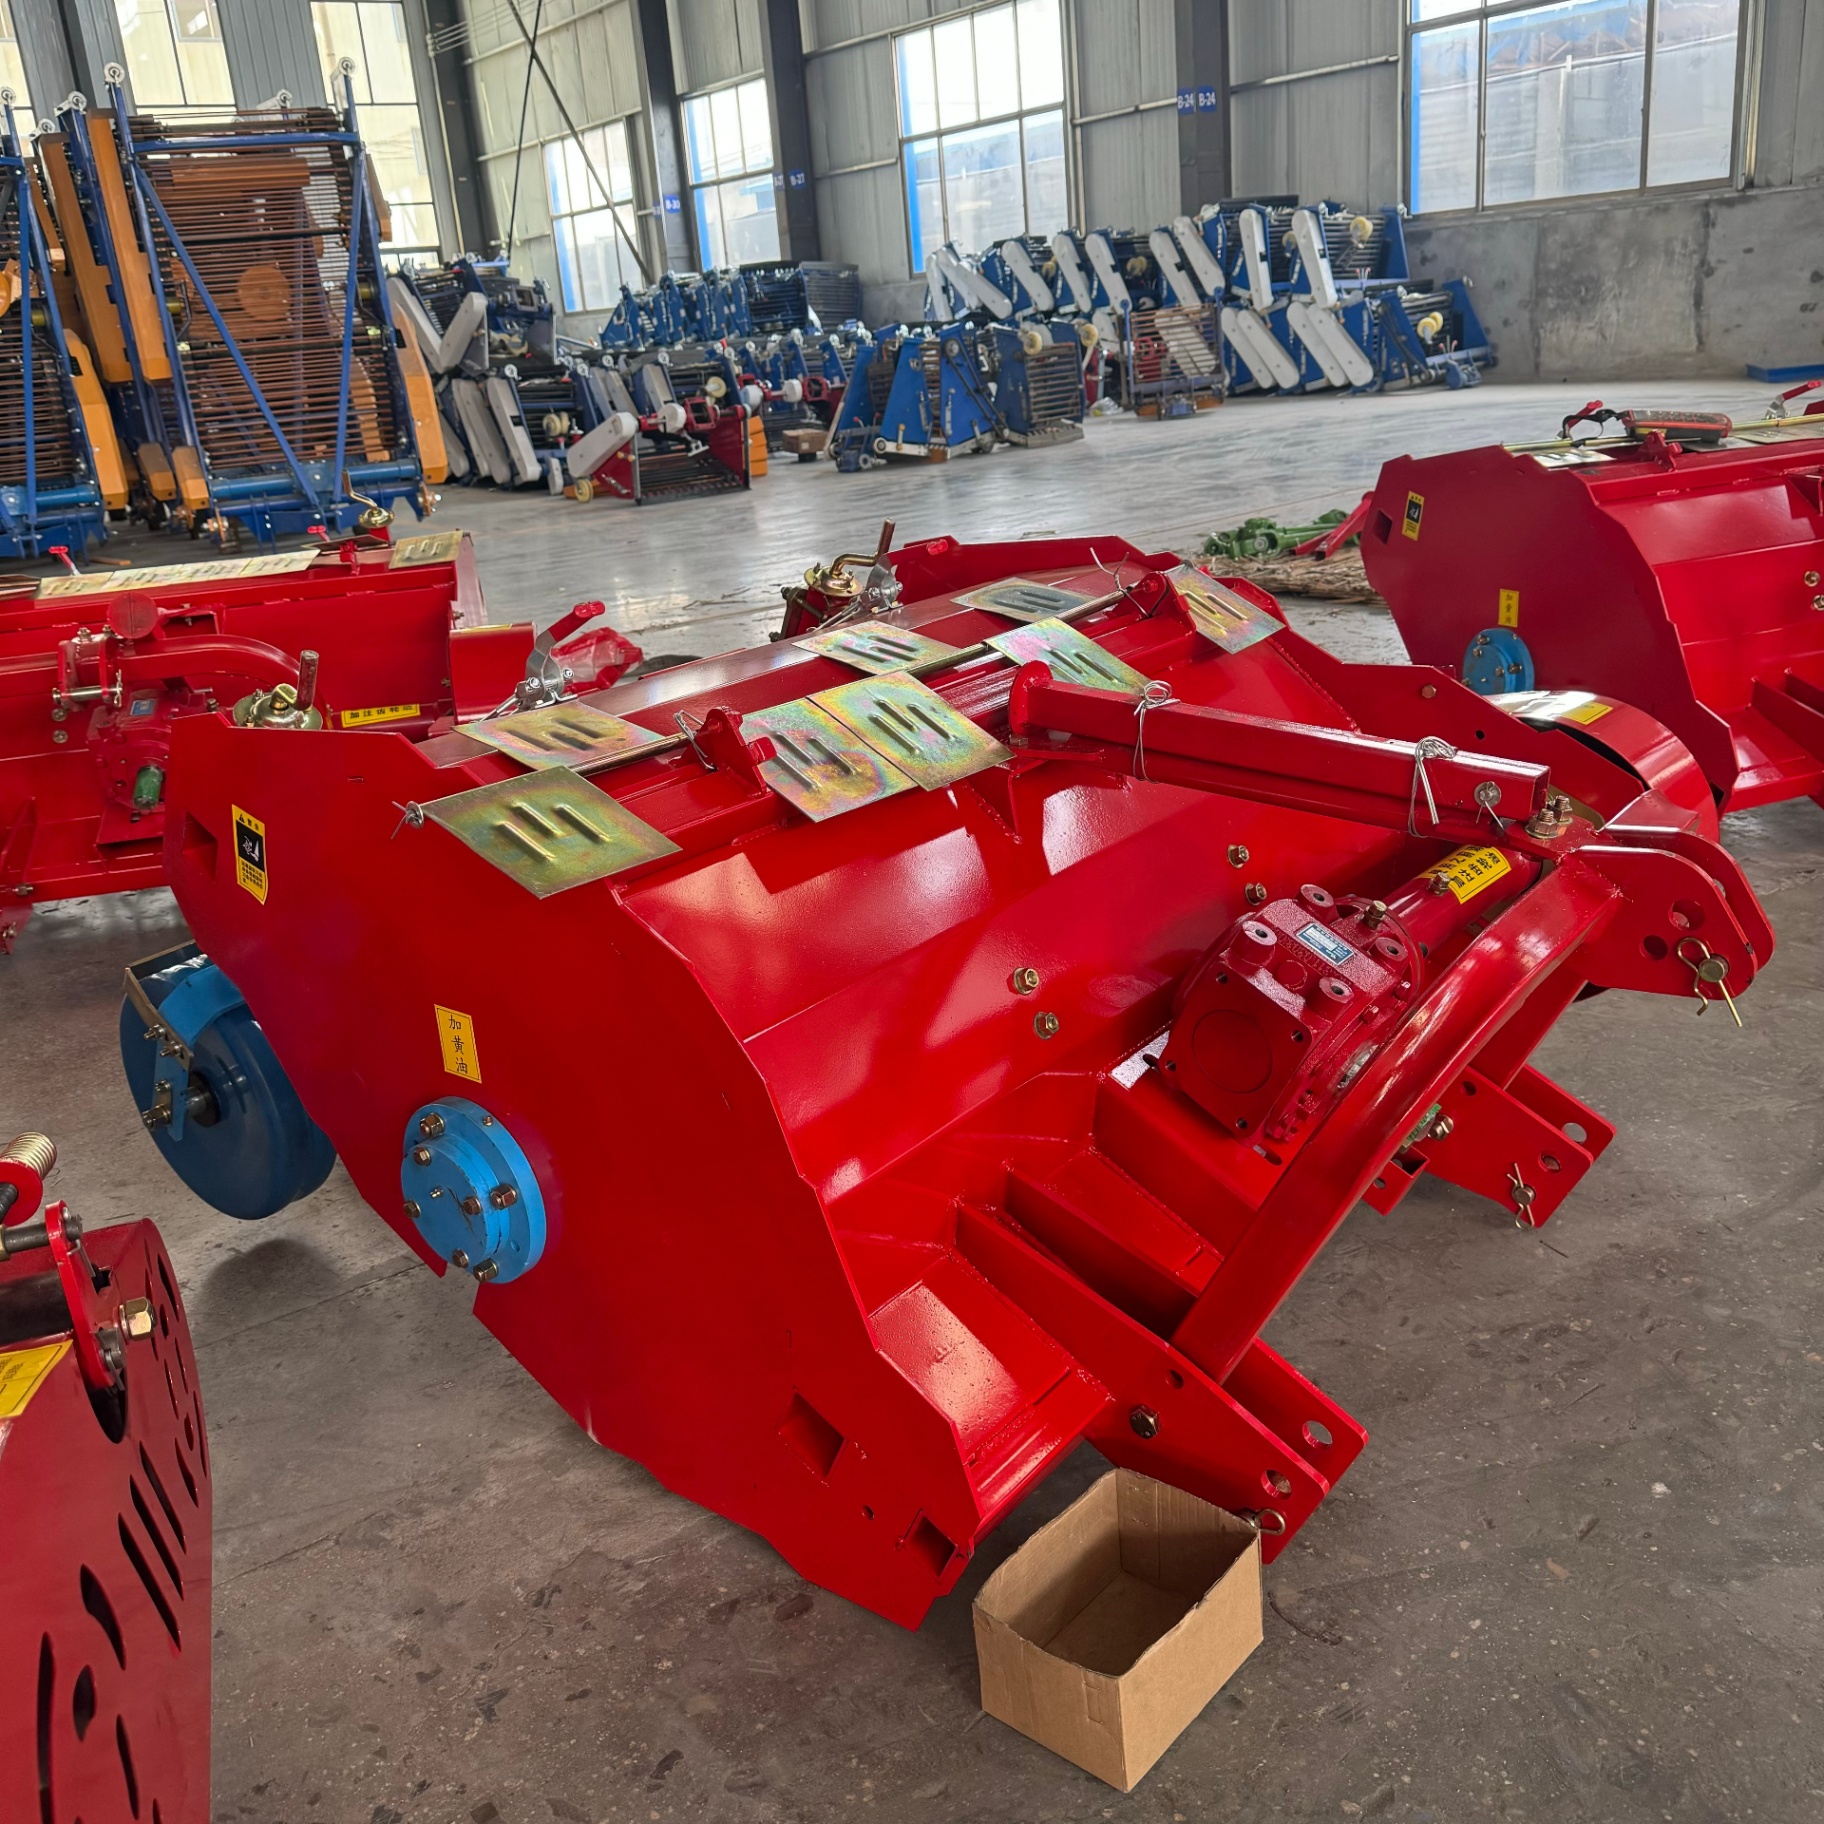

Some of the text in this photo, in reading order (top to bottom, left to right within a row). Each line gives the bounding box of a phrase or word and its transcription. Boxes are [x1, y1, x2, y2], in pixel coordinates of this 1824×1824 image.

[1177, 93, 1194, 109] B-24
[1198, 91, 1216, 107] B-24
[1450, 851, 1501, 889] 加注齿轮油
[448, 1014, 468, 1075] 加黄油
